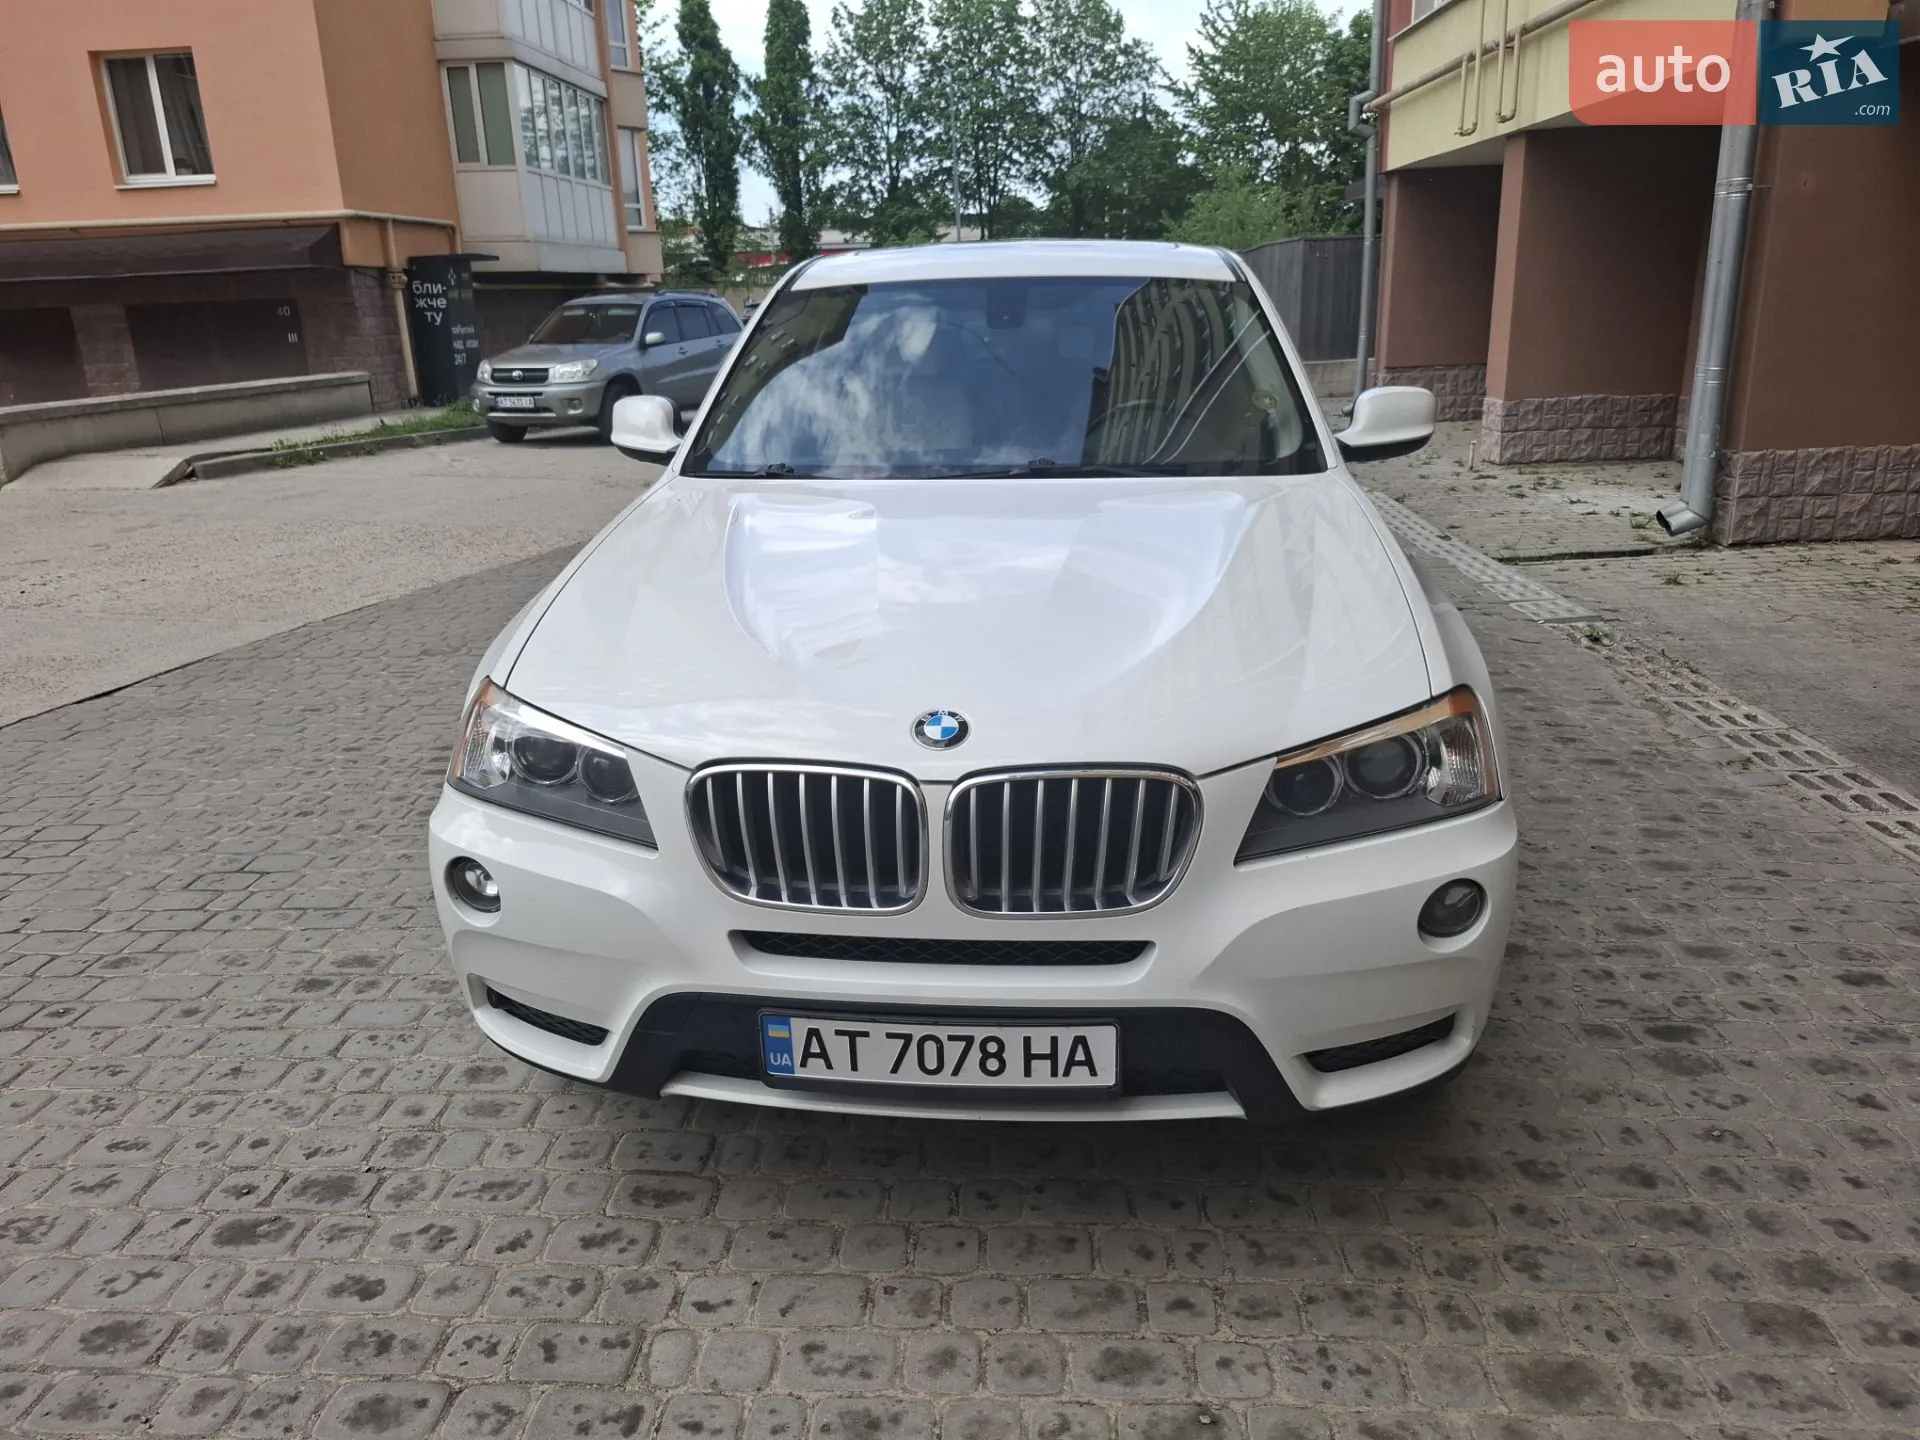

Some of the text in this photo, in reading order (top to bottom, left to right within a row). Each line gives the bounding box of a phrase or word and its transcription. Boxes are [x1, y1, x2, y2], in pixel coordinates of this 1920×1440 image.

[415, 297, 448, 309] жче
[424, 311, 443, 327] ту
[770, 1052, 792, 1068] UA
[799, 1027, 1098, 1078] AT 7078 HA
